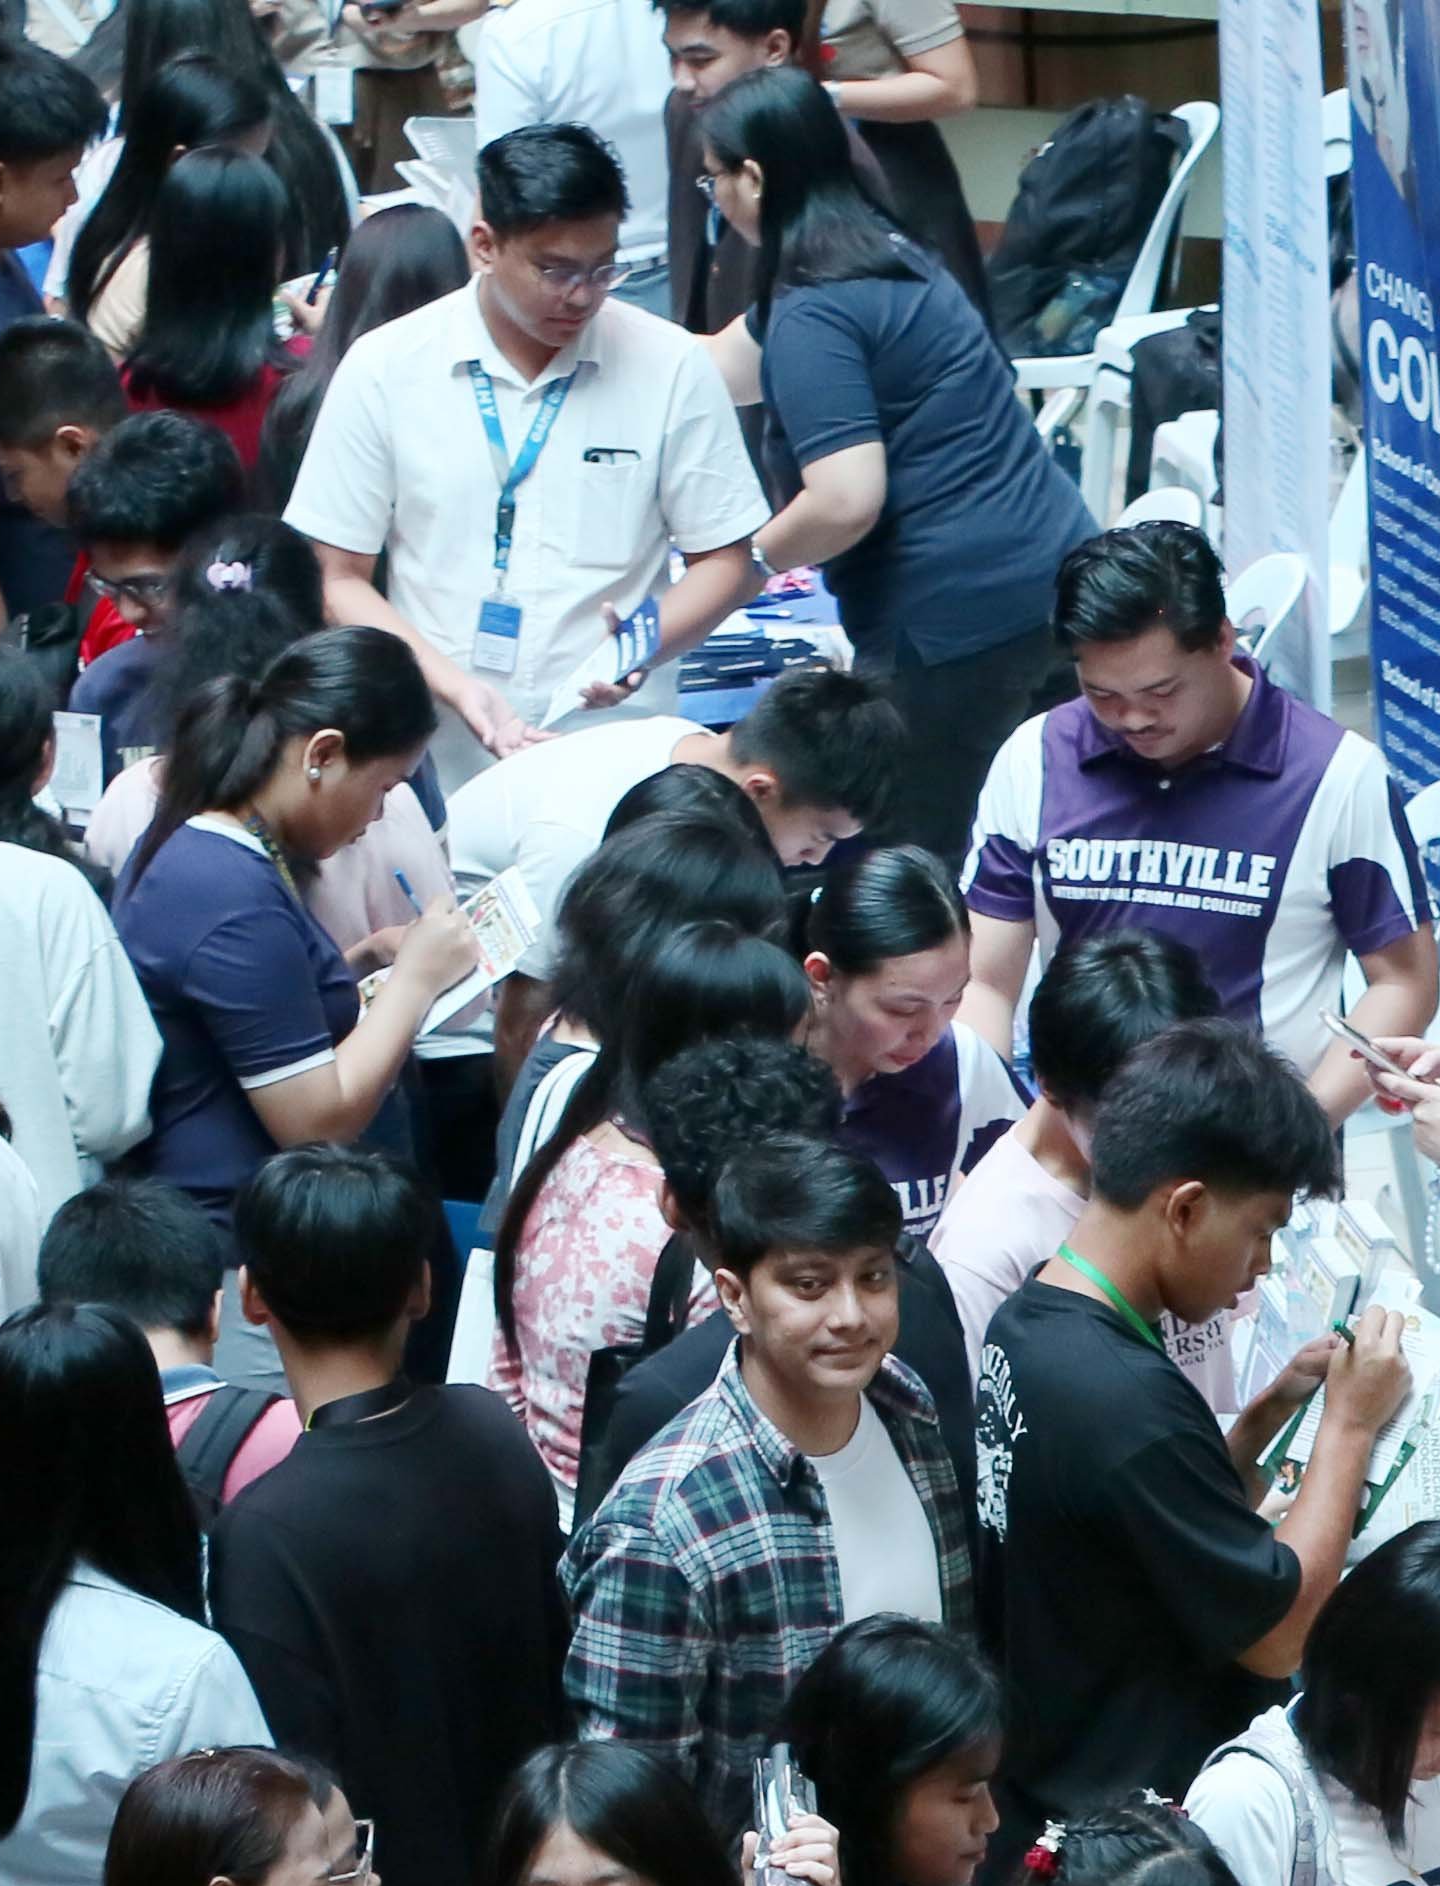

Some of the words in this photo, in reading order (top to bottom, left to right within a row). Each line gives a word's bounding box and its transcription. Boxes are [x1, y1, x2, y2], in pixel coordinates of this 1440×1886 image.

[1046, 838, 1277, 899] SOUTHVILLE
[1132, 888, 1174, 906] SCHOOL
[1175, 893, 1201, 909] AND
[1201, 896, 1262, 918] COLLEGES
